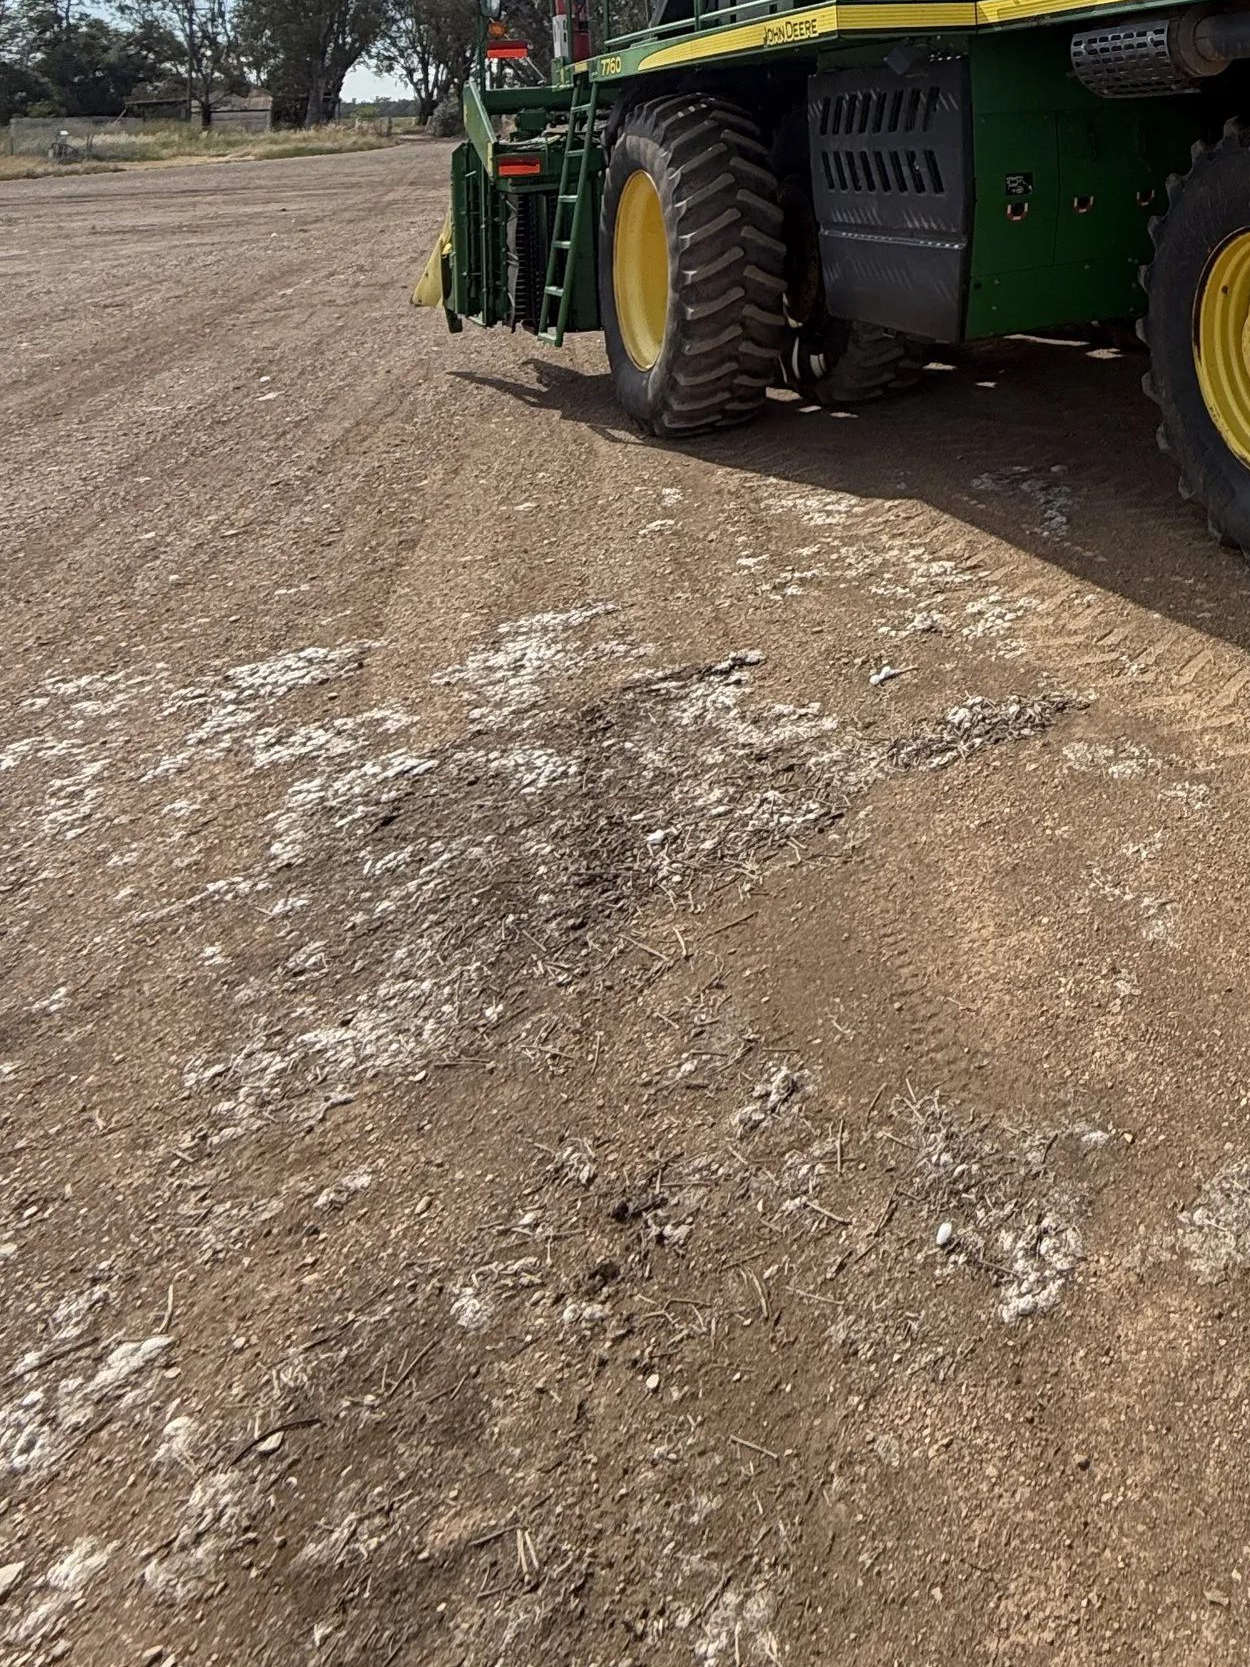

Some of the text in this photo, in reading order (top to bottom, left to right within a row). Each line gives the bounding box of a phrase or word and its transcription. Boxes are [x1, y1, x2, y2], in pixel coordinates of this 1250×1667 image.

[763, 18, 819, 45] JOHN DEERE
[601, 56, 622, 76] 7760
